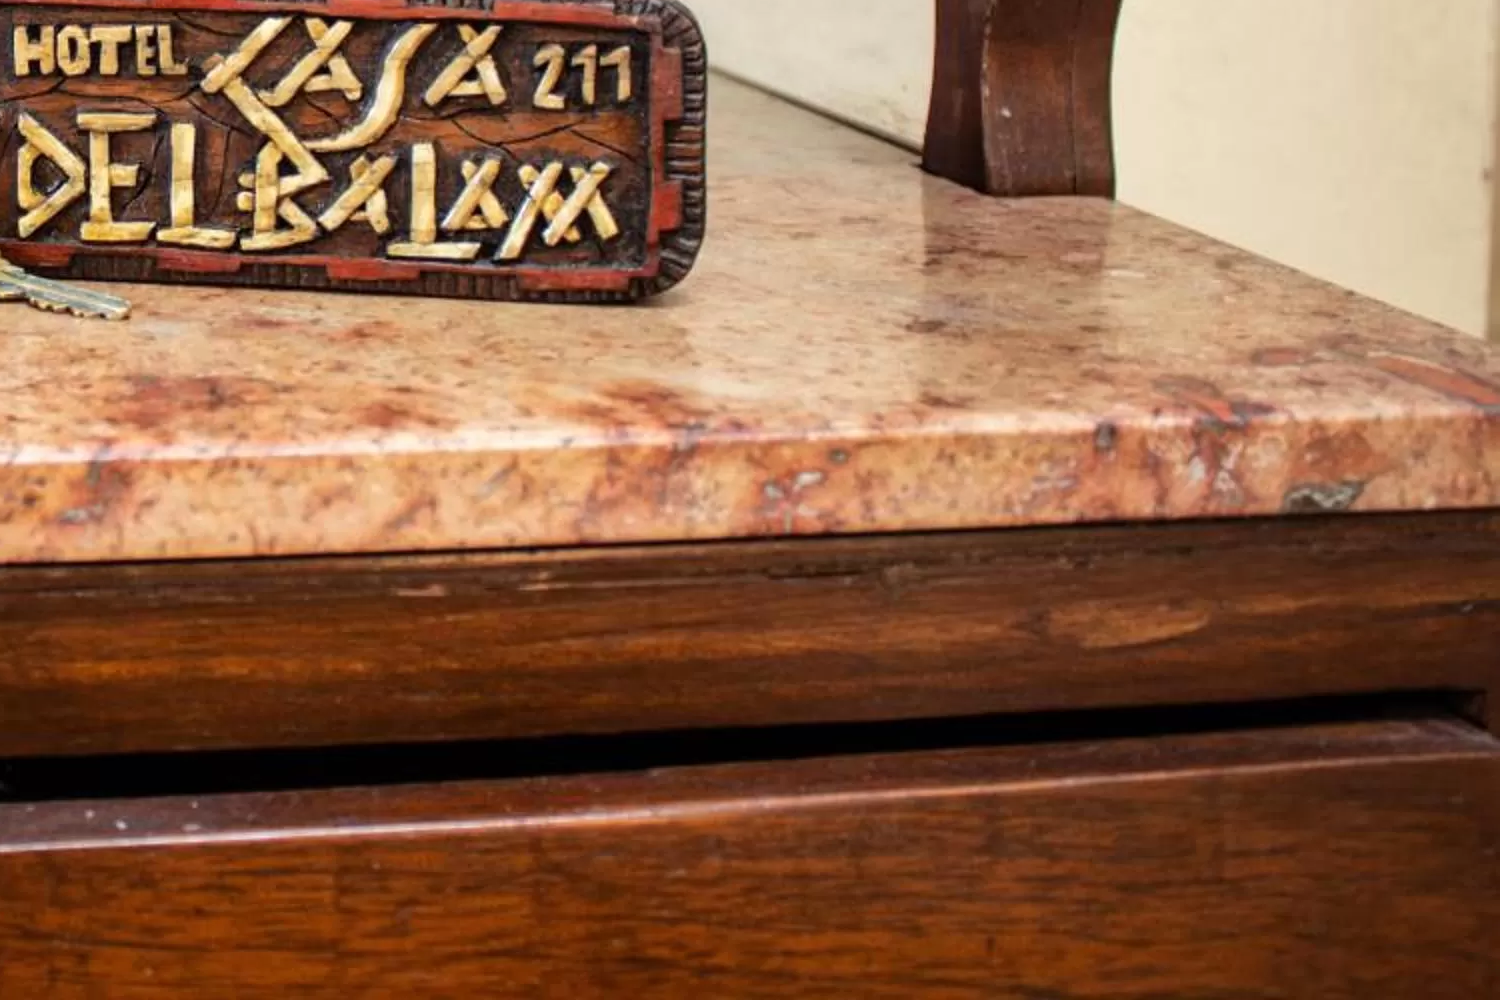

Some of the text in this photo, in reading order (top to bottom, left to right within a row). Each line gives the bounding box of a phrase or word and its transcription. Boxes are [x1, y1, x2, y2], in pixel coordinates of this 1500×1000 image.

[12, 15, 632, 168] HOTEL CASA 211
[16, 111, 240, 250] DEL
